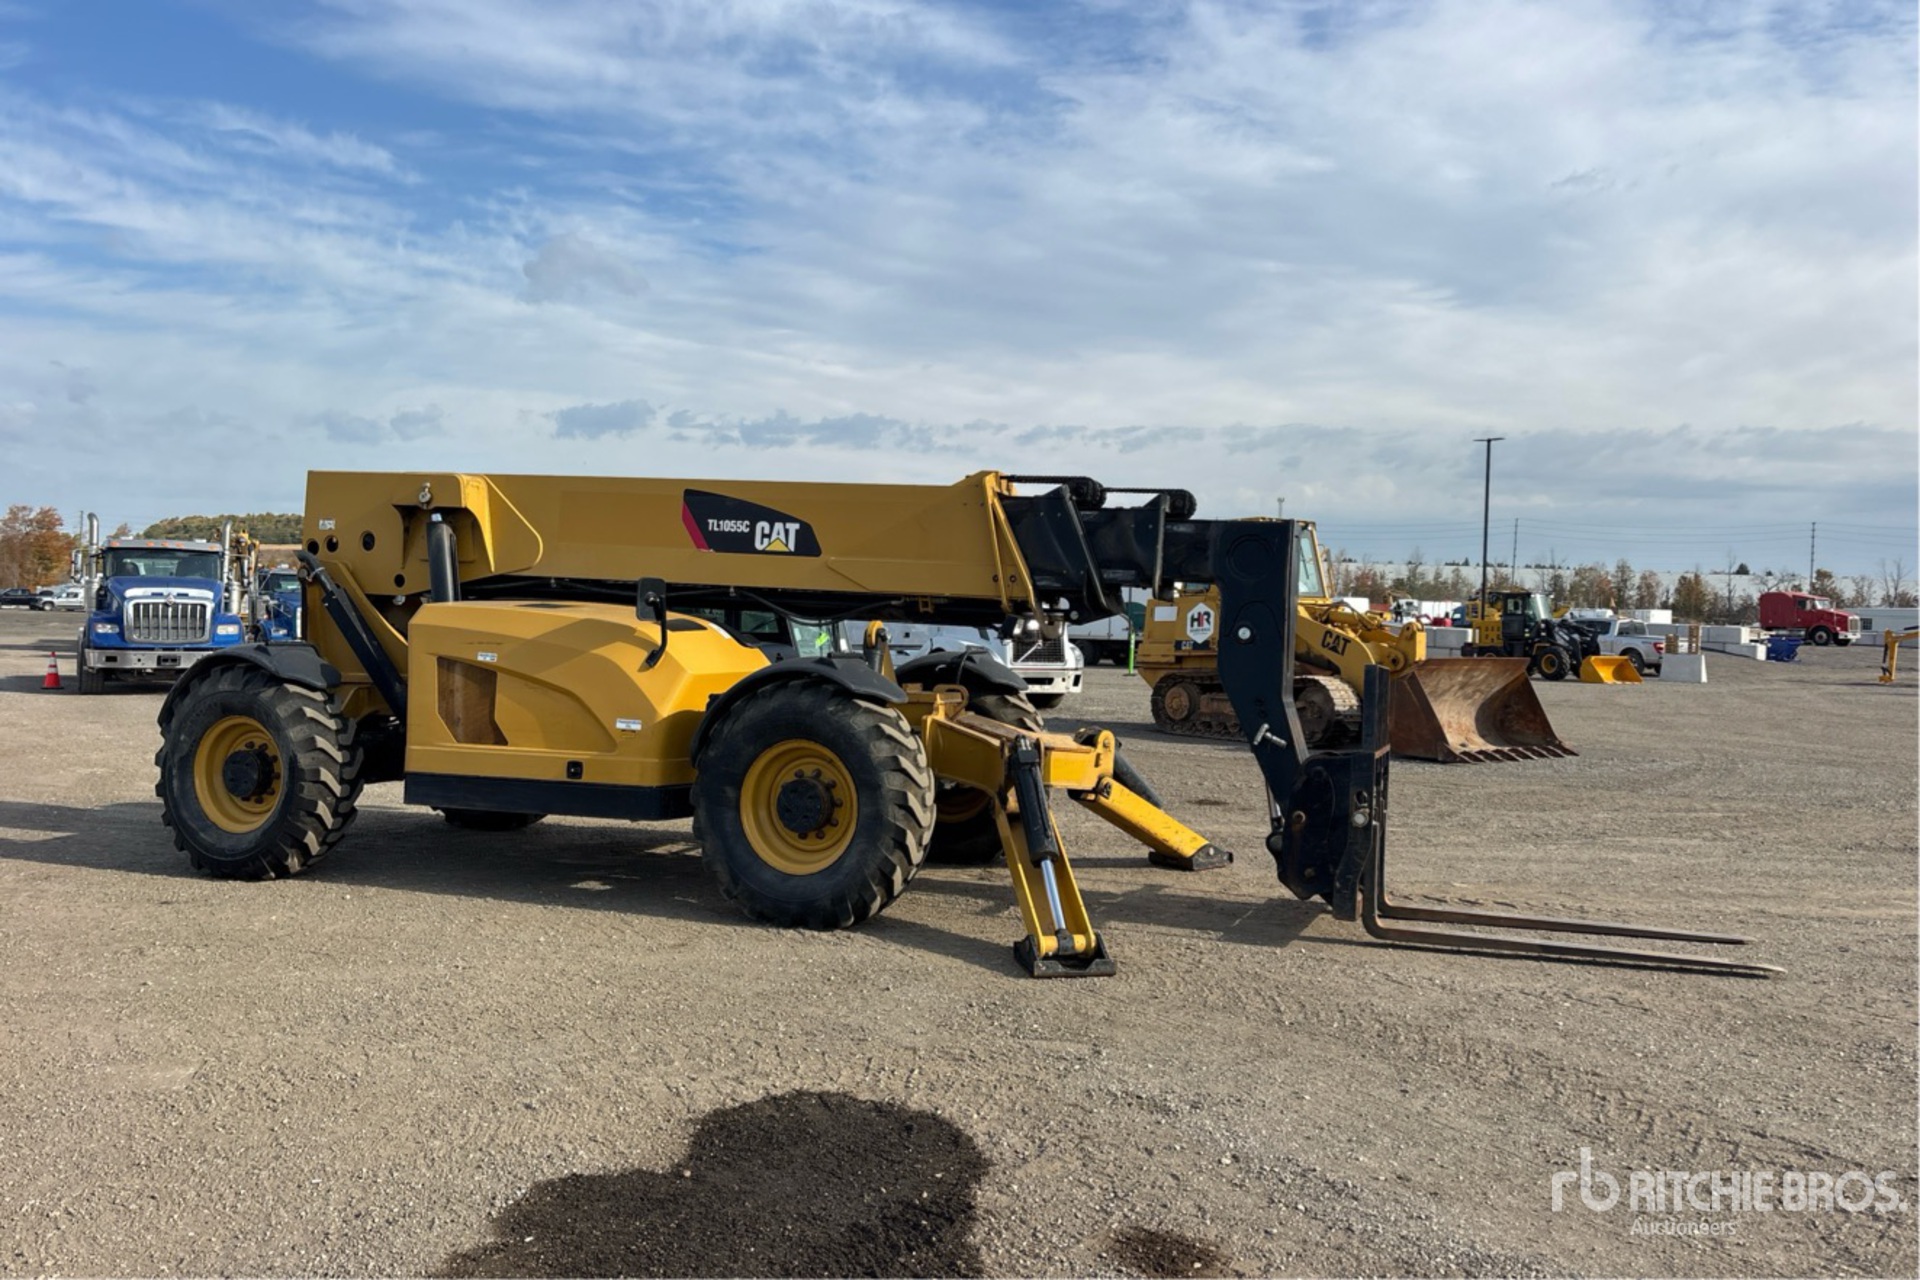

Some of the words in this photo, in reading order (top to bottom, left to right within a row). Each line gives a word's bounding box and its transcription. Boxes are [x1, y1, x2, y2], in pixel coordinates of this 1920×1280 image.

[707, 519, 750, 532] TL1055C
[754, 521, 800, 552] CAT
[1321, 630, 1351, 656] CAT
